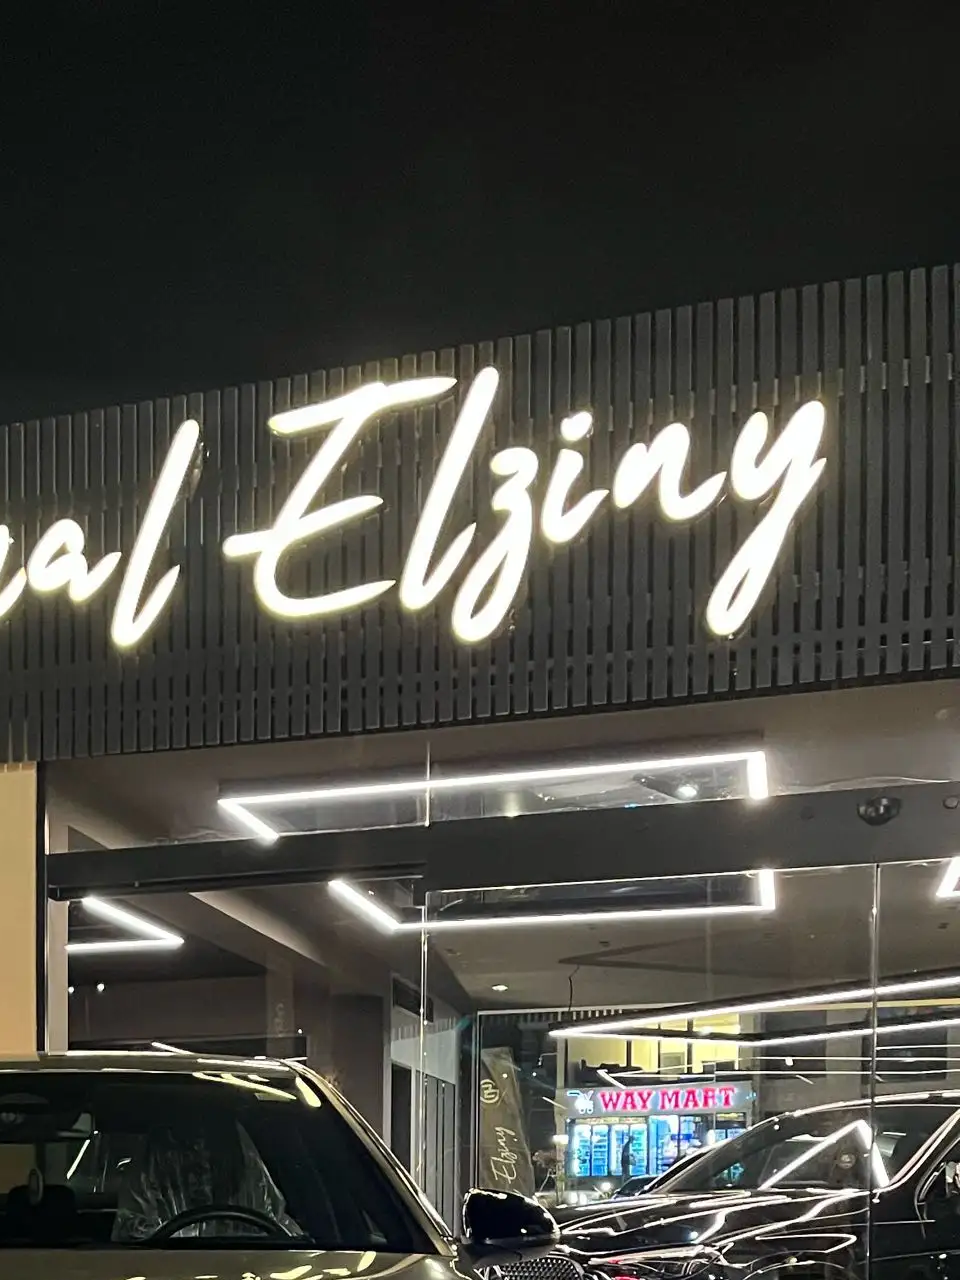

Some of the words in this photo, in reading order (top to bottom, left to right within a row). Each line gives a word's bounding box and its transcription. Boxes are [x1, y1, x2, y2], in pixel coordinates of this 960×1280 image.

[222, 366, 828, 643] Elziny
[599, 1089, 653, 1111] WAY
[659, 1087, 736, 1110] MART
